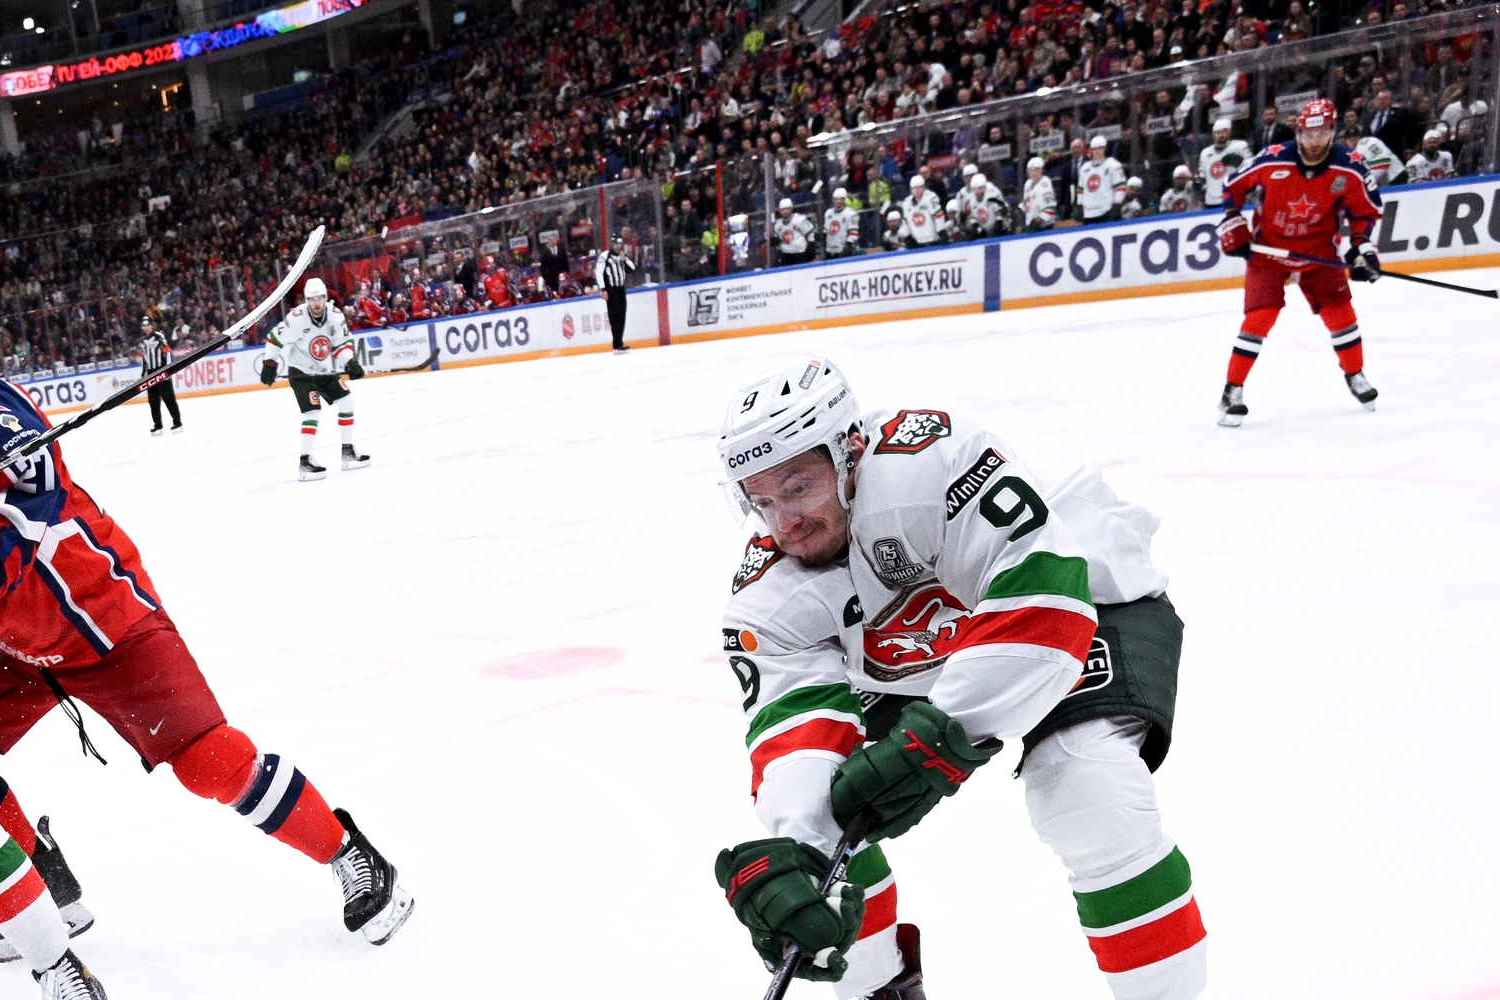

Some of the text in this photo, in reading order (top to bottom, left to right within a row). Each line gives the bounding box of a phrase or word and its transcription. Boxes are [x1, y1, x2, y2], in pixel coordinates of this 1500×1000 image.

[56, 52, 142, 82] ПЛЕЙ-ОФФ
[1029, 222, 1221, 287] согаз
[818, 267, 963, 304] CSKA-HOCKEY.RU
[445, 315, 530, 355] согаз
[581, 312, 613, 336] ЦСК
[139, 372, 167, 392] CCM
[176, 357, 236, 389] FONBET
[800, 366, 818, 389] Winline
[27, 379, 88, 407] огаз
[741, 391, 759, 414] 9
[828, 389, 848, 410] BAUER
[728, 441, 773, 469] согаз
[946, 454, 1000, 514] Winline
[978, 475, 1050, 543] 9
[729, 655, 761, 713] 9
